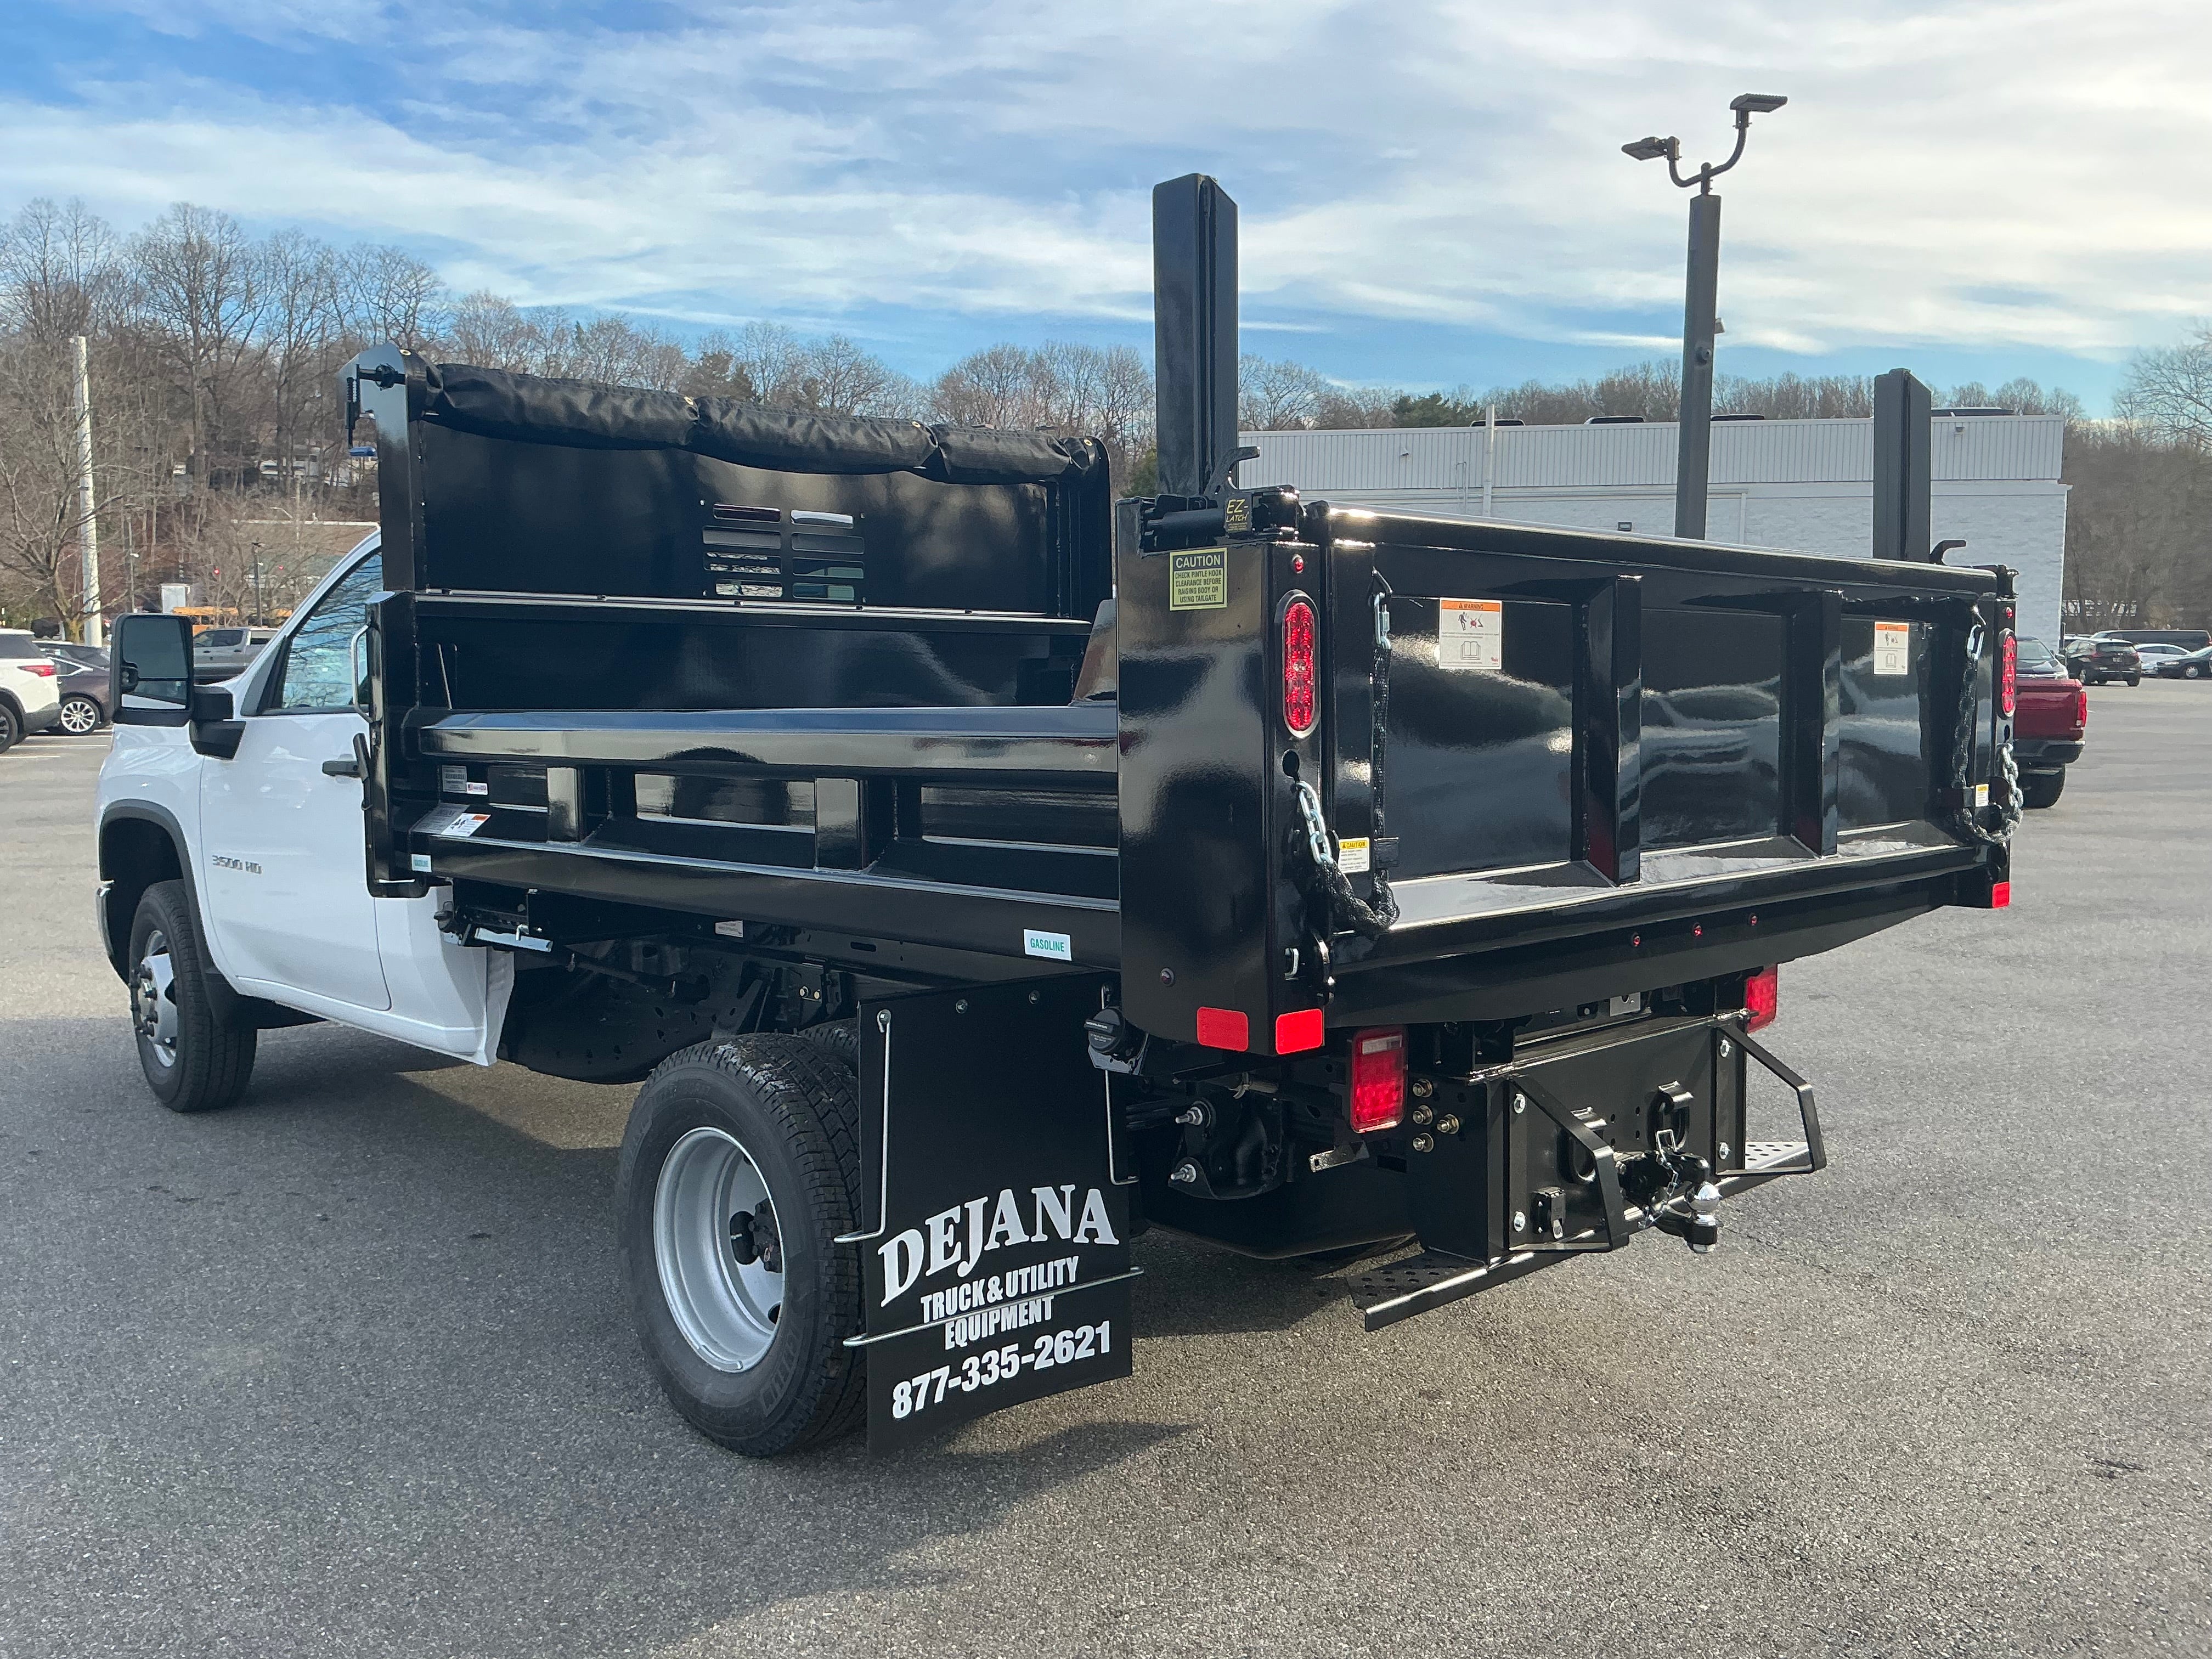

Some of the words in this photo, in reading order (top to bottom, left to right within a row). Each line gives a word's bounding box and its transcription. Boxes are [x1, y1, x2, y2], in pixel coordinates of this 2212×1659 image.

[1226, 514, 1248, 523] LATCH
[1176, 554, 1221, 569] CAUTION
[1175, 571, 1190, 579] CHECK
[1191, 570, 1207, 578] PINTLE
[1209, 569, 1222, 577] HOOK
[1175, 579, 1203, 588] CLEARANCE
[1203, 577, 1222, 585] BEFORE
[1178, 587, 1197, 595] RAISING
[1198, 586, 1211, 594] BODY
[1195, 594, 1217, 602] TAILGATE
[1030, 938, 1065, 952] GASOLINE
[877, 1183, 1120, 1308] DEJANA
[945, 1295, 1054, 1351] EQUIPMENT
[891, 1319, 1110, 1420] 877-335-2621
